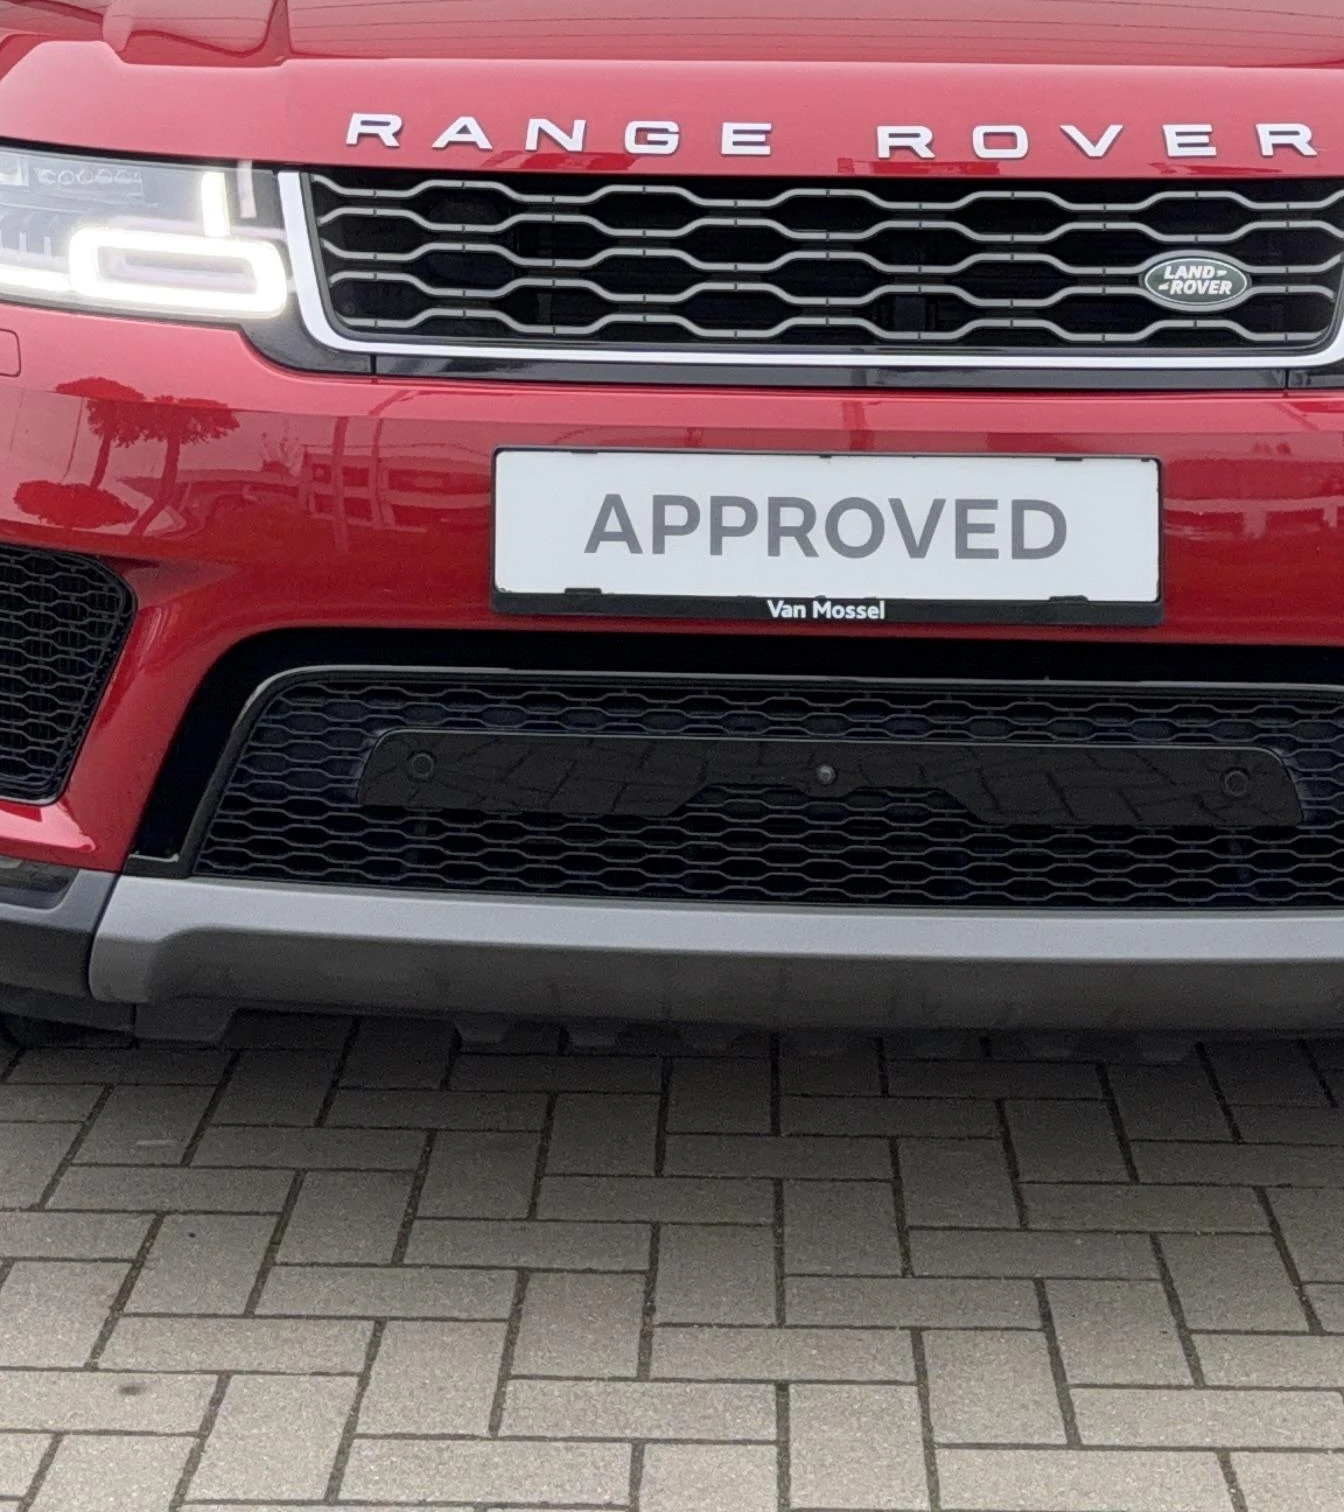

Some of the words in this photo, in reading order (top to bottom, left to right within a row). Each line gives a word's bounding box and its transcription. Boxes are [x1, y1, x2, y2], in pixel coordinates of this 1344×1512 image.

[346, 113, 773, 156] RANGE
[876, 123, 1317, 159] ROVER
[1164, 265, 1215, 279] LAND
[1170, 279, 1232, 295] ROVER
[584, 493, 1067, 560] APPROVED
[766, 599, 806, 618] Van
[812, 600, 885, 620] Mossel
